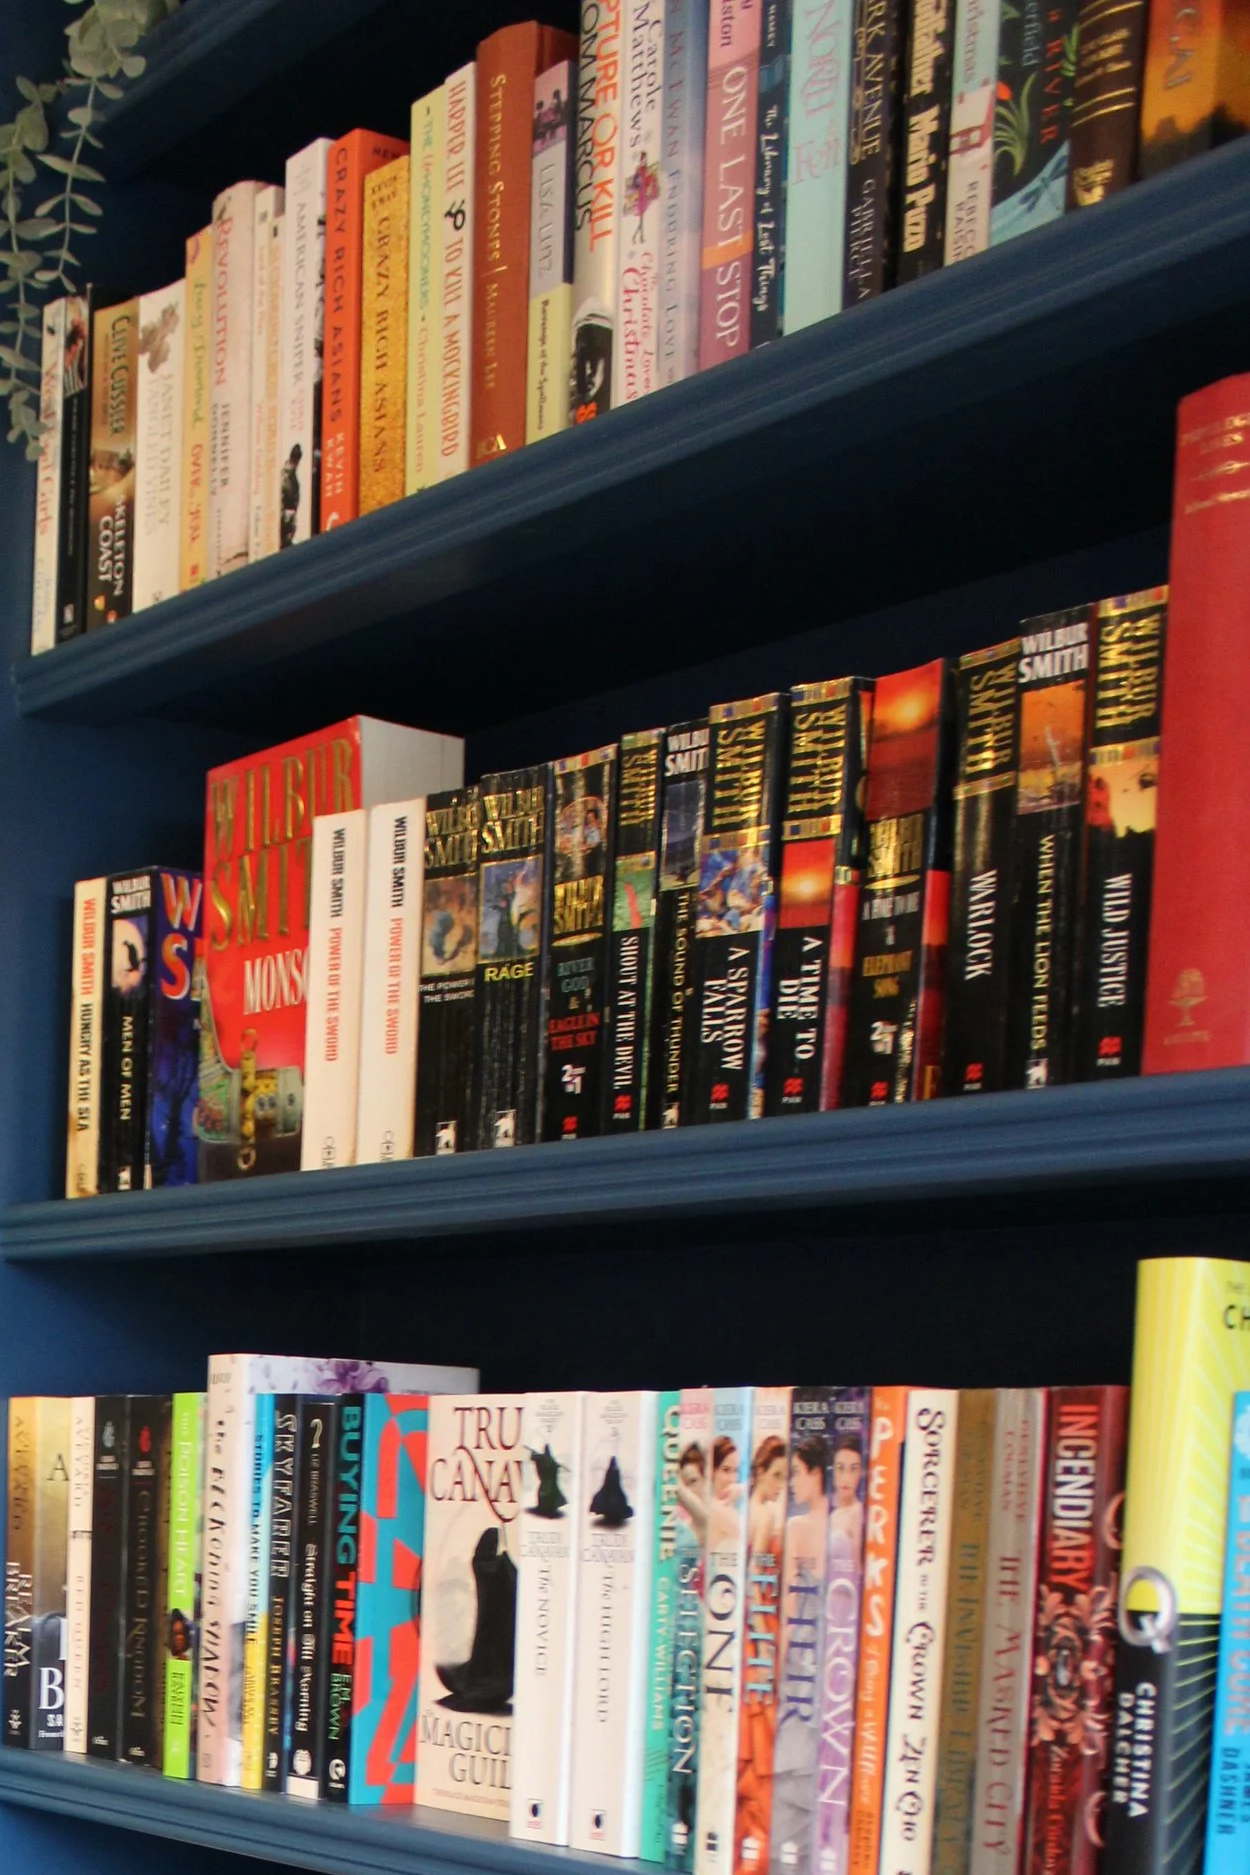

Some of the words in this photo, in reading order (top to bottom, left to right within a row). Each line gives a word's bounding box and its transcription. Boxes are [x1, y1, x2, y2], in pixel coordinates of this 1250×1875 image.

[643, 20, 663, 109] Carole
[447, 81, 467, 155] HARPER
[720, 65, 748, 145] ONE
[574, 74, 598, 232] MARCUS
[592, 113, 619, 174] OR
[333, 148, 347, 237] CRAZY
[589, 179, 615, 253] KILL
[717, 156, 747, 247] LAST
[332, 244, 347, 313] RICH
[714, 261, 743, 348] STOP
[111, 315, 129, 360] CLIVE
[330, 325, 346, 423] ASIANS
[98, 515, 113, 583] COAST
[1018, 644, 1089, 683] SMITH
[210, 734, 355, 857] WILBUR
[330, 827, 346, 881] WILBUR
[1038, 834, 1055, 894] WHEN
[81, 897, 97, 949] WILBUR
[329, 884, 345, 919] SMITH
[965, 869, 998, 981] WARLOCK
[1036, 898, 1053, 934] THE
[1103, 873, 1133, 922] WILD
[80, 951, 96, 996] SMITH
[327, 927, 342, 969] POWER
[483, 962, 535, 983] RAGE
[619, 936, 639, 987] SHOUT
[674, 927, 688, 984] SOUND
[1033, 940, 1051, 988] LION
[1097, 926, 1130, 1008] JUSTICE
[701, 977, 728, 1044] FALLS
[720, 967, 749, 1070] SPARROW
[777, 978, 801, 1020] DIE
[797, 960, 820, 1020] TIME
[1030, 992, 1049, 1051] FEEDS
[121, 1016, 134, 1051] MEN
[616, 1010, 636, 1039] THE
[666, 1016, 683, 1094] THUNDER
[794, 1029, 817, 1060] TO
[120, 1057, 133, 1081] OF
[613, 1041, 635, 1091] DEVIL
[119, 1084, 132, 1121] MEN
[269, 1409, 299, 1579] SKYFARER
[335, 1406, 362, 1565] BUYING
[1050, 1403, 1101, 1594] INCENDIARY
[865, 1416, 894, 1637] PERKS
[331, 1580, 356, 1665] TIME
[705, 1573, 737, 1697] ONE
[819, 1578, 858, 1806] CROWN
[1113, 1691, 1136, 1804] DALCHER
[1128, 1681, 1157, 1818] CHRISTINA
